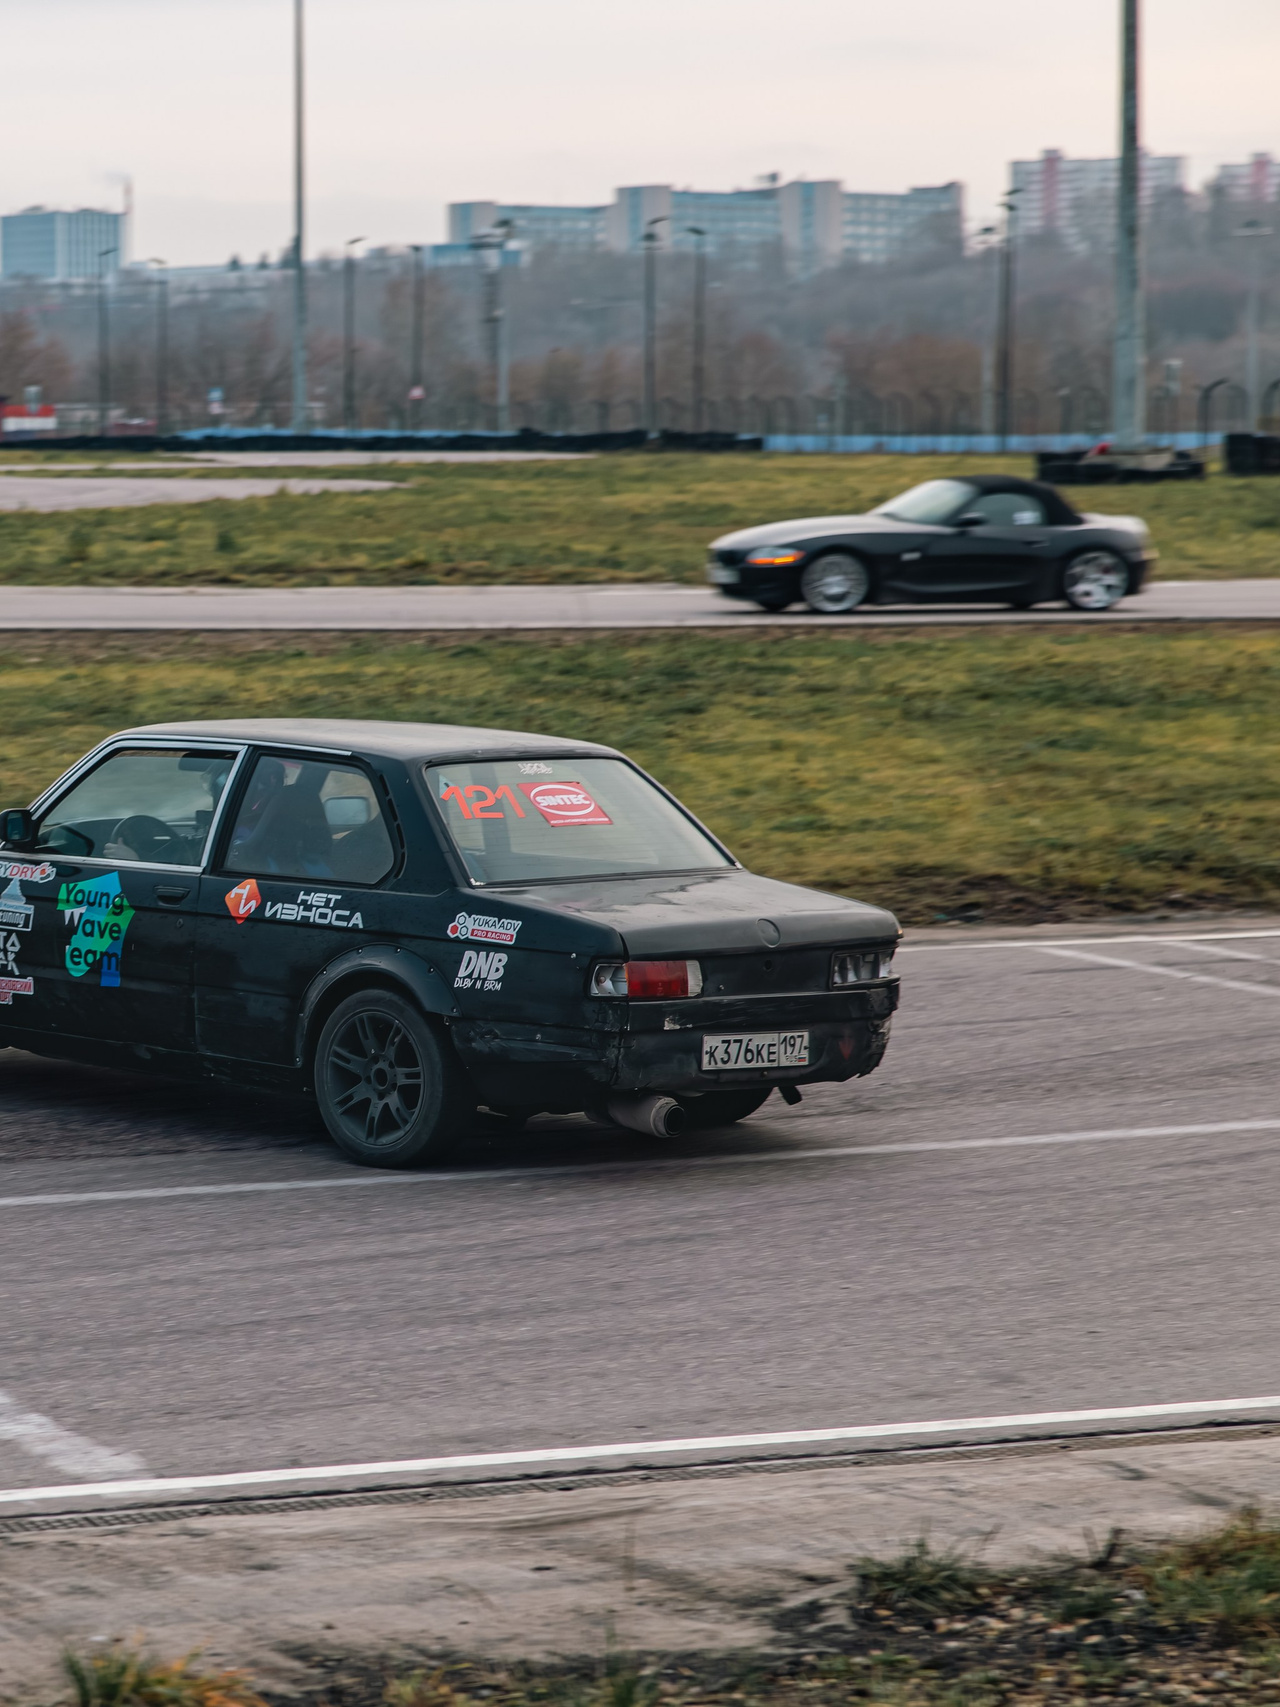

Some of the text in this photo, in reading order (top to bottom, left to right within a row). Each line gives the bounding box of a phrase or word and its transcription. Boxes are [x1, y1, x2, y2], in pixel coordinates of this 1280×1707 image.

[441, 785, 526, 819] 121
[534, 794, 591, 807] SINTEC
[65, 884, 124, 916] Young
[297, 890, 342, 907] НЕТ
[265, 902, 363, 929] ИЗНОСА
[473, 916, 520, 932] YUKA ADV
[487, 932, 511, 940] RACING
[458, 950, 508, 980] DNB
[484, 980, 502, 991] BRM
[781, 1035, 804, 1055] 197
